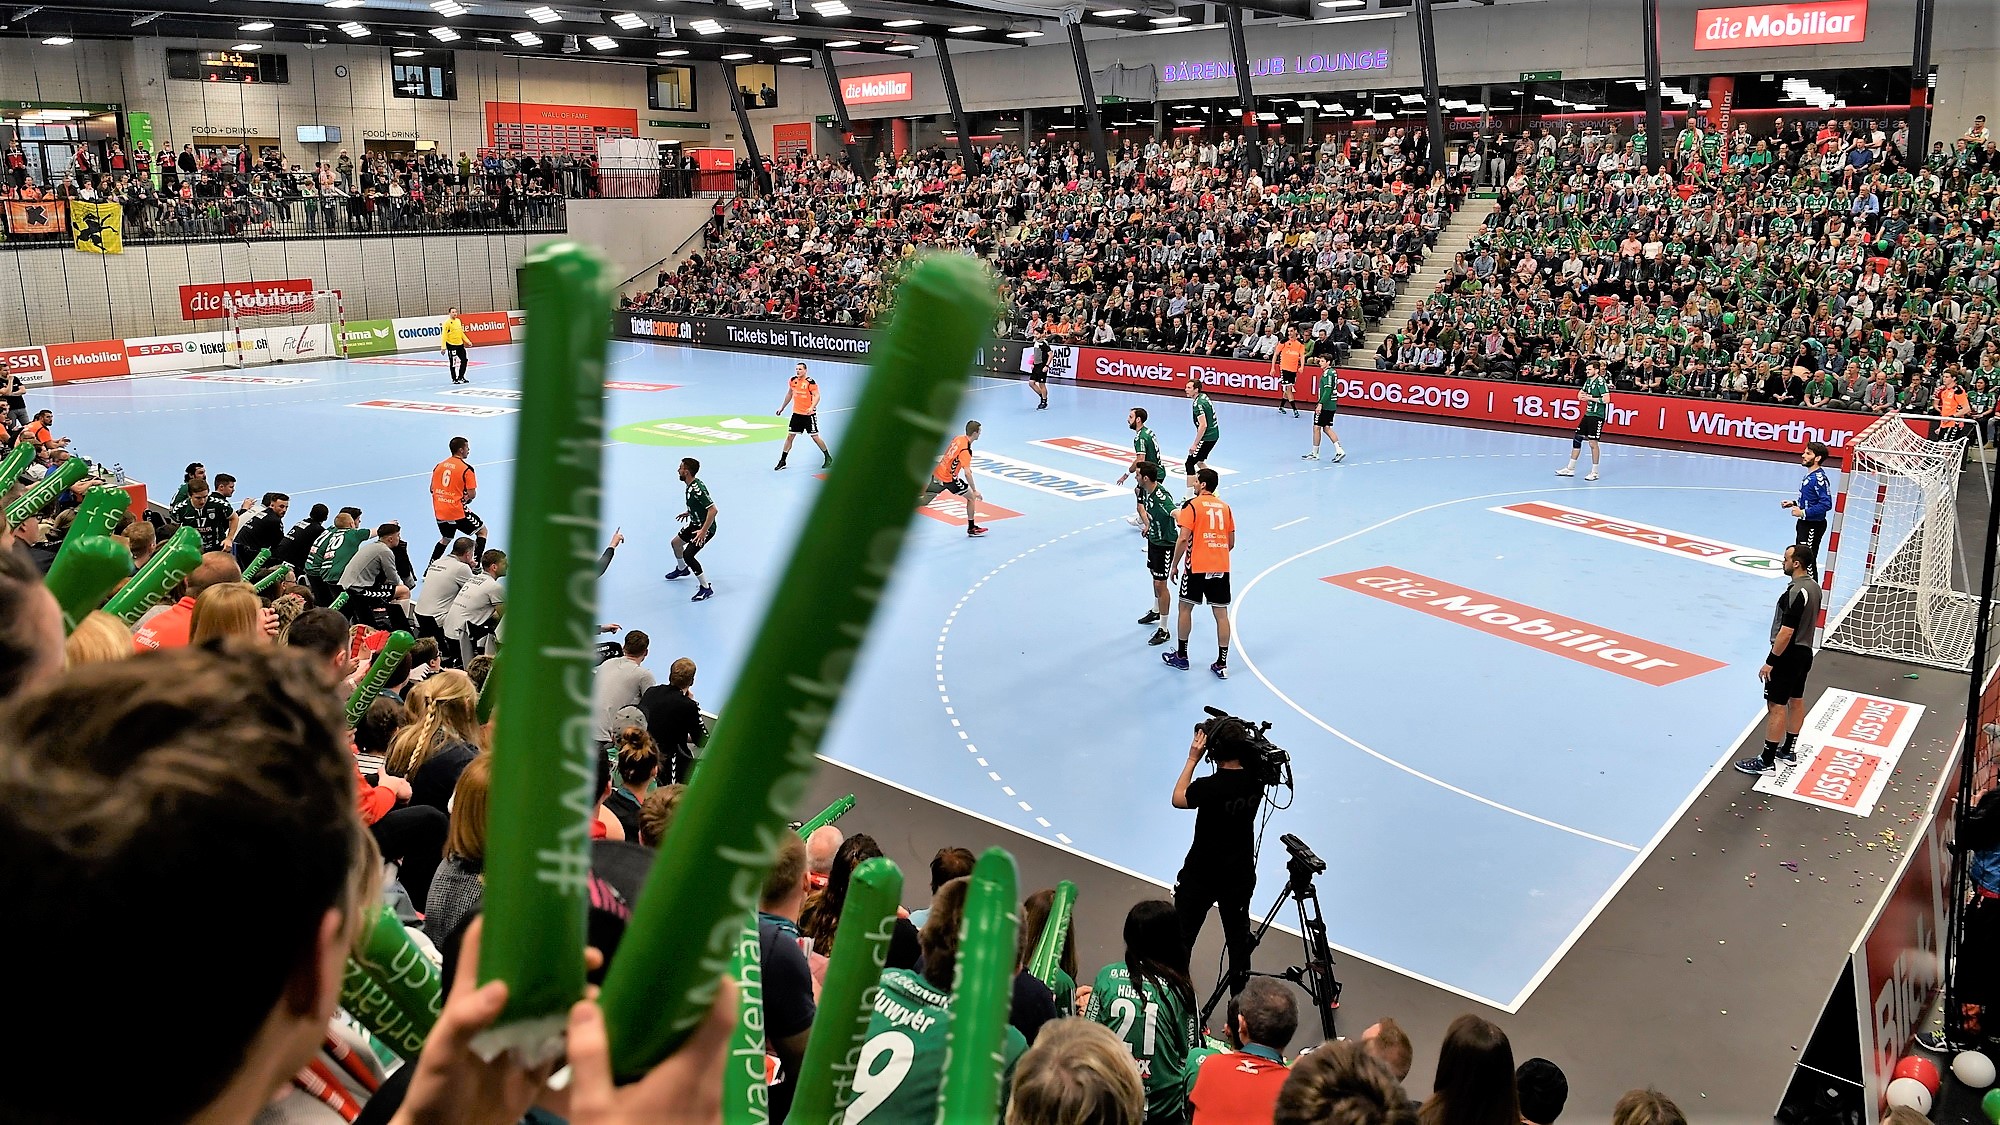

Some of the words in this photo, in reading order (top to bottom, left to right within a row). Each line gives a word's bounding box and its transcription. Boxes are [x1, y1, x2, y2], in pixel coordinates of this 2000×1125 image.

[1705, 17, 1743, 41] die
[1745, 12, 1856, 38] Mobiliar
[1296, 49, 1389, 74] LOUNGE
[845, 84, 861, 99] die
[861, 80, 908, 97] Mobiliar
[541, 111, 559, 119] WALL
[571, 112, 589, 120] FAME
[190, 126, 217, 135] FOOD
[225, 127, 258, 135] DRINKS
[362, 130, 384, 138] FOOD
[391, 131, 420, 139] DRINKS
[190, 291, 220, 312] die
[221, 286, 306, 309] Mobiliar
[469, 321, 506, 332] Mobiliar
[630, 316, 692, 340] ticketcorner.ch
[139, 341, 183, 356] SPAR
[199, 338, 268, 355] ticketcoer.ch
[726, 324, 768, 345] Tickets
[769, 326, 788, 346] bei
[789, 330, 871, 354] Ticketcorner
[9, 354, 41, 369] SSR
[53, 354, 72, 368] die
[72, 350, 123, 365] Mobiliar
[1053, 347, 1071, 358] AND
[1095, 356, 1173, 382] Schweiz
[1337, 378, 1470, 409] 05.06.2019
[1512, 395, 1580, 421] 18.15
[1687, 410, 1854, 449] Winterthur
[1071, 442, 1173, 467] SP
[441, 469, 452, 487] 6
[196, 517, 207, 528] 17
[1205, 507, 1225, 531] 11
[1551, 511, 1726, 557] SPAR
[1354, 573, 1439, 600] die
[1431, 595, 1681, 674] Mobiliar
[1117, 984, 1153, 1001] Hüsr
[1110, 997, 1159, 1056] 21
[842, 1029, 916, 1125] 9
